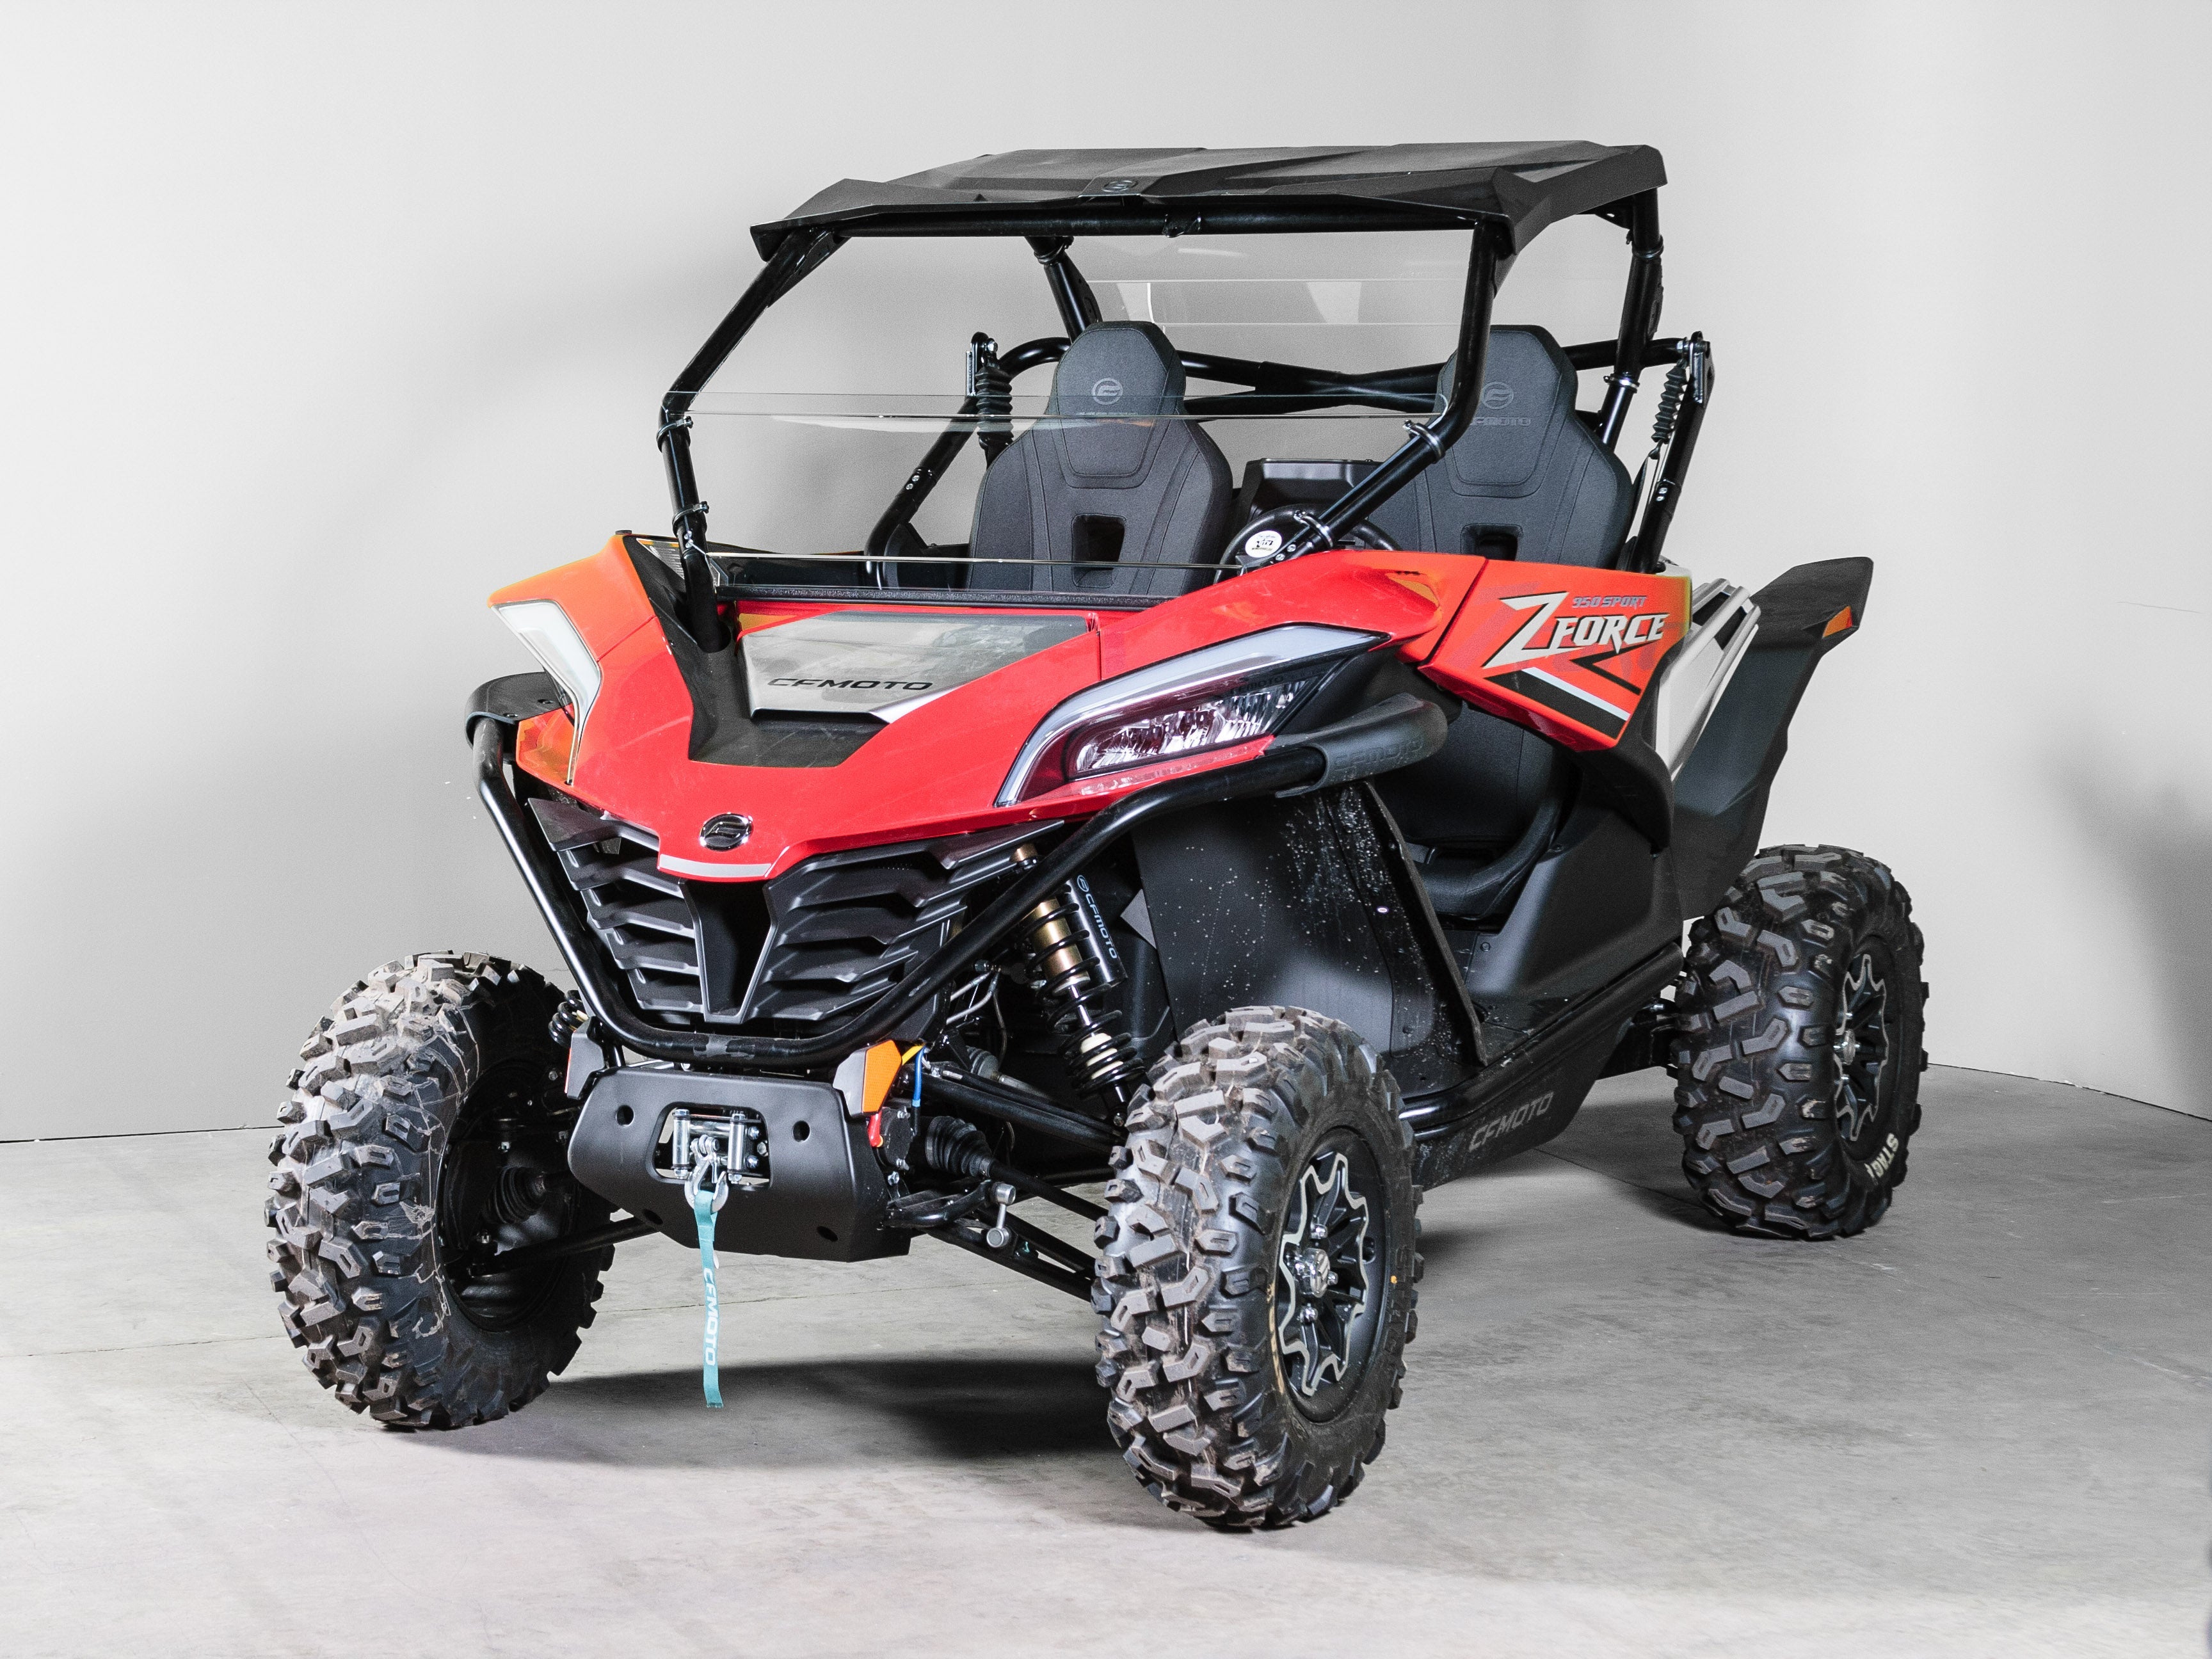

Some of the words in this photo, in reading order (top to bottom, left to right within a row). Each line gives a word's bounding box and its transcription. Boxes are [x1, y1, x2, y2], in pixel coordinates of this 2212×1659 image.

[1572, 597, 1601, 608] 950
[1601, 595, 1647, 609] SPORT
[768, 678, 933, 691] CFMOTO
[1086, 894, 1118, 959] CFMOTO
[1469, 1091, 1554, 1152] CFMOTO
[704, 1268, 718, 1366] CFMOTO
